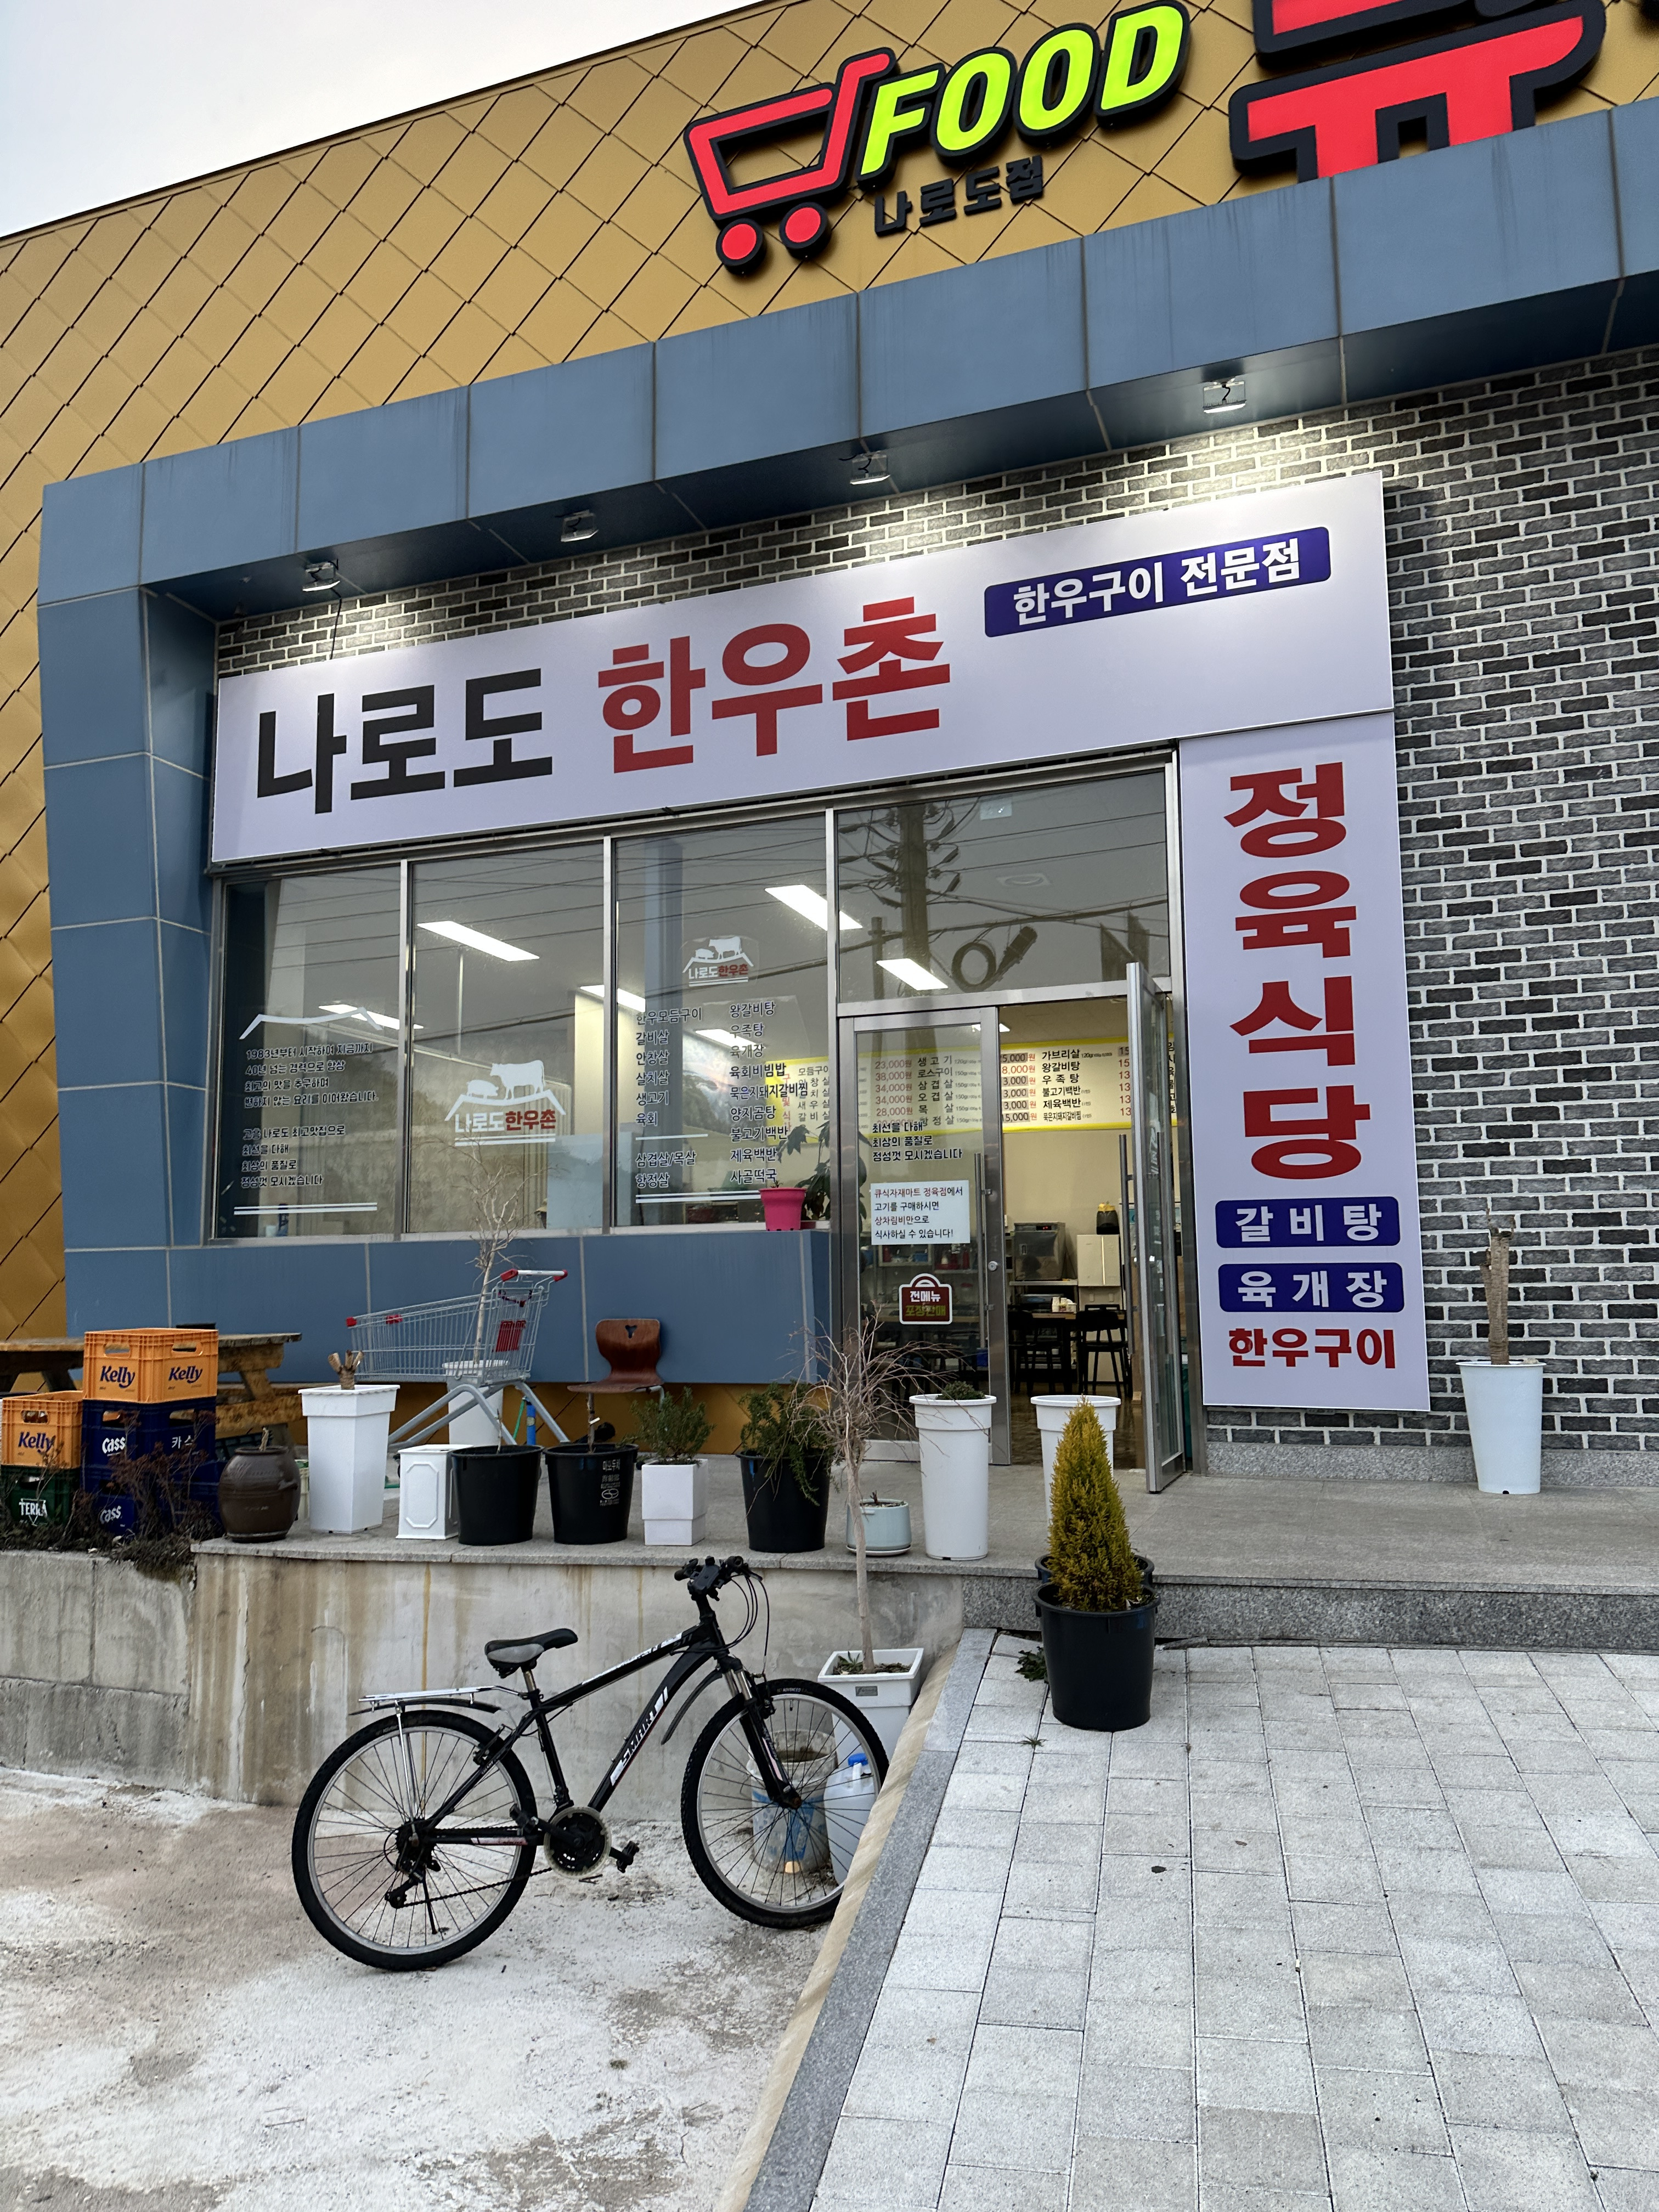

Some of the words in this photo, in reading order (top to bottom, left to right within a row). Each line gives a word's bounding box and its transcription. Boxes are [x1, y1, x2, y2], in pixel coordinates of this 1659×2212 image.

[859, 3, 1186, 178] FOOD
[874, 155, 1043, 236] 나로도점
[1013, 567, 1164, 624] 한우구이
[1181, 543, 1300, 596] 전문점
[258, 668, 552, 814] 나로도
[599, 597, 951, 772] 한우촌
[1224, 761, 1370, 1180] 정육식당
[637, 1007, 702, 1025] 한우모듬구이
[730, 1001, 775, 1018] 왕갈비탕
[636, 1030, 669, 1045] 갈비살
[730, 1023, 764, 1038] 우족탕
[247, 1048, 296, 1059] 1983년부터
[299, 1045, 333, 1057] 시작하여
[337, 1043, 373, 1054] 지금까지
[636, 1049, 669, 1065] 안창살
[730, 1044, 764, 1059] 육개장
[1042, 1049, 1080, 1060] 가브리살
[246, 1065, 266, 1075] 40년
[270, 1064, 286, 1074] 넘는
[290, 1062, 324, 1073] 경력으로
[327, 1060, 345, 1070] 항상
[730, 1063, 786, 1079] 육회비빔밥
[875, 1059, 912, 1069] 23,000원
[1042, 1061, 1080, 1073] 왕갈비탕
[636, 1070, 669, 1086] 살치살
[876, 1071, 912, 1081] 38,000원
[917, 1067, 952, 1078] 로스구이
[245, 1081, 270, 1092] 최고의
[274, 1080, 291, 1090] 맛을
[294, 1078, 329, 1088] 추구하며
[730, 1082, 808, 1100] 묵은지돼지갈비찜
[875, 1083, 912, 1093] 34,000원
[1042, 1086, 1081, 1097] 불고기백반
[245, 1097, 269, 1108] 변하지
[274, 1096, 290, 1106] 않는
[294, 1094, 319, 1105] 요리를
[323, 1091, 379, 1103] 이어왔습니다.
[636, 1091, 668, 1105] 생고기
[876, 1094, 912, 1105] 34,000원
[1043, 1098, 1081, 1109] 제육백반
[636, 1111, 658, 1126] 육회
[731, 1105, 776, 1121] 양지곰탕
[243, 1128, 261, 1139] 고흥
[264, 1127, 289, 1138] 나로도
[292, 1125, 345, 1137] 최고맛집으로
[731, 1126, 788, 1142] 불고기백반
[872, 1123, 900, 1133] 최선을
[905, 1122, 923, 1131] 다해
[872, 1137, 900, 1148] 최상의
[905, 1135, 933, 1146] 품질로
[242, 1144, 268, 1155] 최선을
[272, 1144, 289, 1154] 다해
[731, 1148, 777, 1163] 제육백반
[873, 1151, 901, 1162] 정성껏
[905, 1149, 962, 1161] 모시겠습니다
[242, 1161, 267, 1171] 최상의
[271, 1160, 296, 1170] 품질로
[636, 1151, 696, 1167] 삼겹살/목살
[241, 1177, 267, 1188] 정성껏
[270, 1175, 323, 1187] 모시겠습니다
[636, 1172, 669, 1188] 항정살
[731, 1169, 777, 1184] 사골떡국
[874, 1188, 921, 1198] 큐식자재마트
[923, 1186, 963, 1197] 정육점에서
[874, 1202, 898, 1212] 고기를
[900, 1201, 939, 1211] 구매하시면
[874, 1216, 930, 1226] 상차림비만으로
[1235, 1204, 1383, 1243] 갈비탕
[875, 1229, 906, 1239] 식사하실
[909, 1229, 916, 1239] 수
[918, 1228, 953, 1239] 있습니다!
[910, 1291, 941, 1302] 전메뉴
[1238, 1271, 1387, 1308] 육개장
[1229, 1328, 1396, 1369] 한우구이
[100, 1365, 135, 1389] Kelly
[168, 1365, 203, 1383] Kelly
[18, 1431, 54, 1454] Kelly
